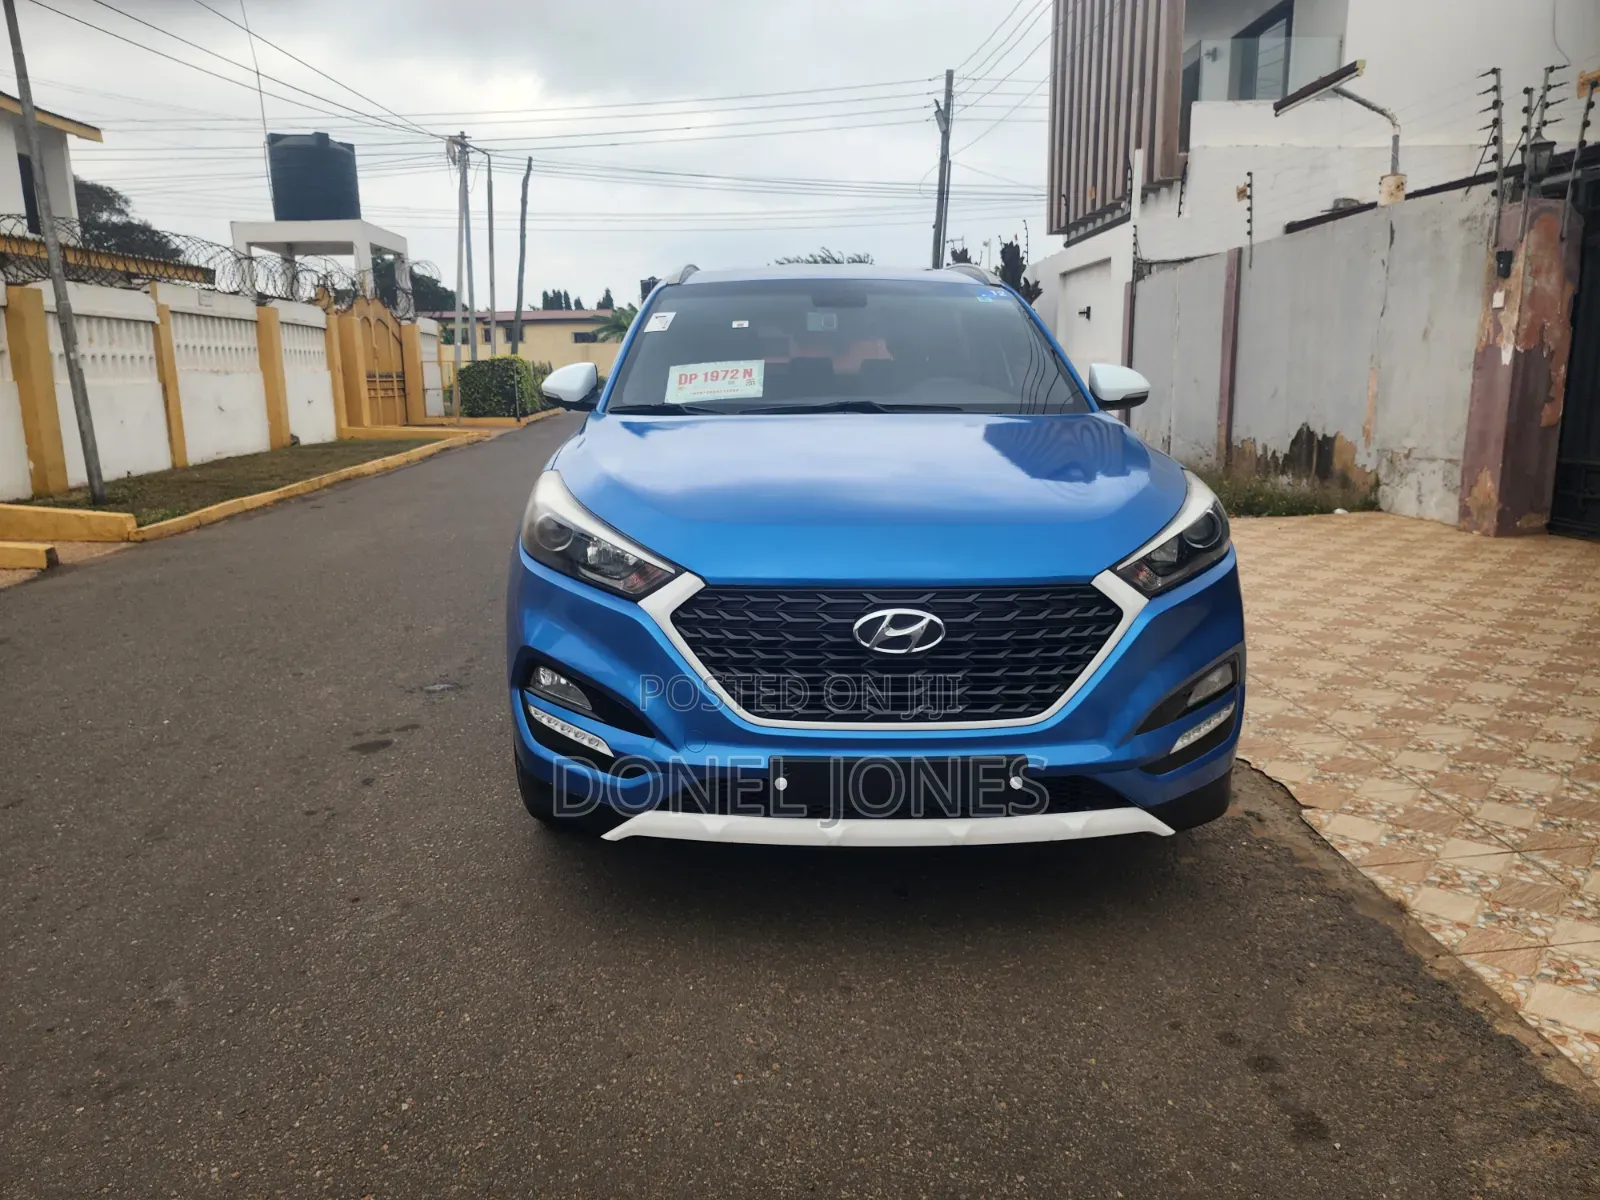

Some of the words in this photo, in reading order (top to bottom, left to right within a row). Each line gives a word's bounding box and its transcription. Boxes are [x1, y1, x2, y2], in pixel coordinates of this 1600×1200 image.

[678, 373, 698, 386] DP
[702, 369, 740, 382] 1972
[743, 368, 753, 379] N
